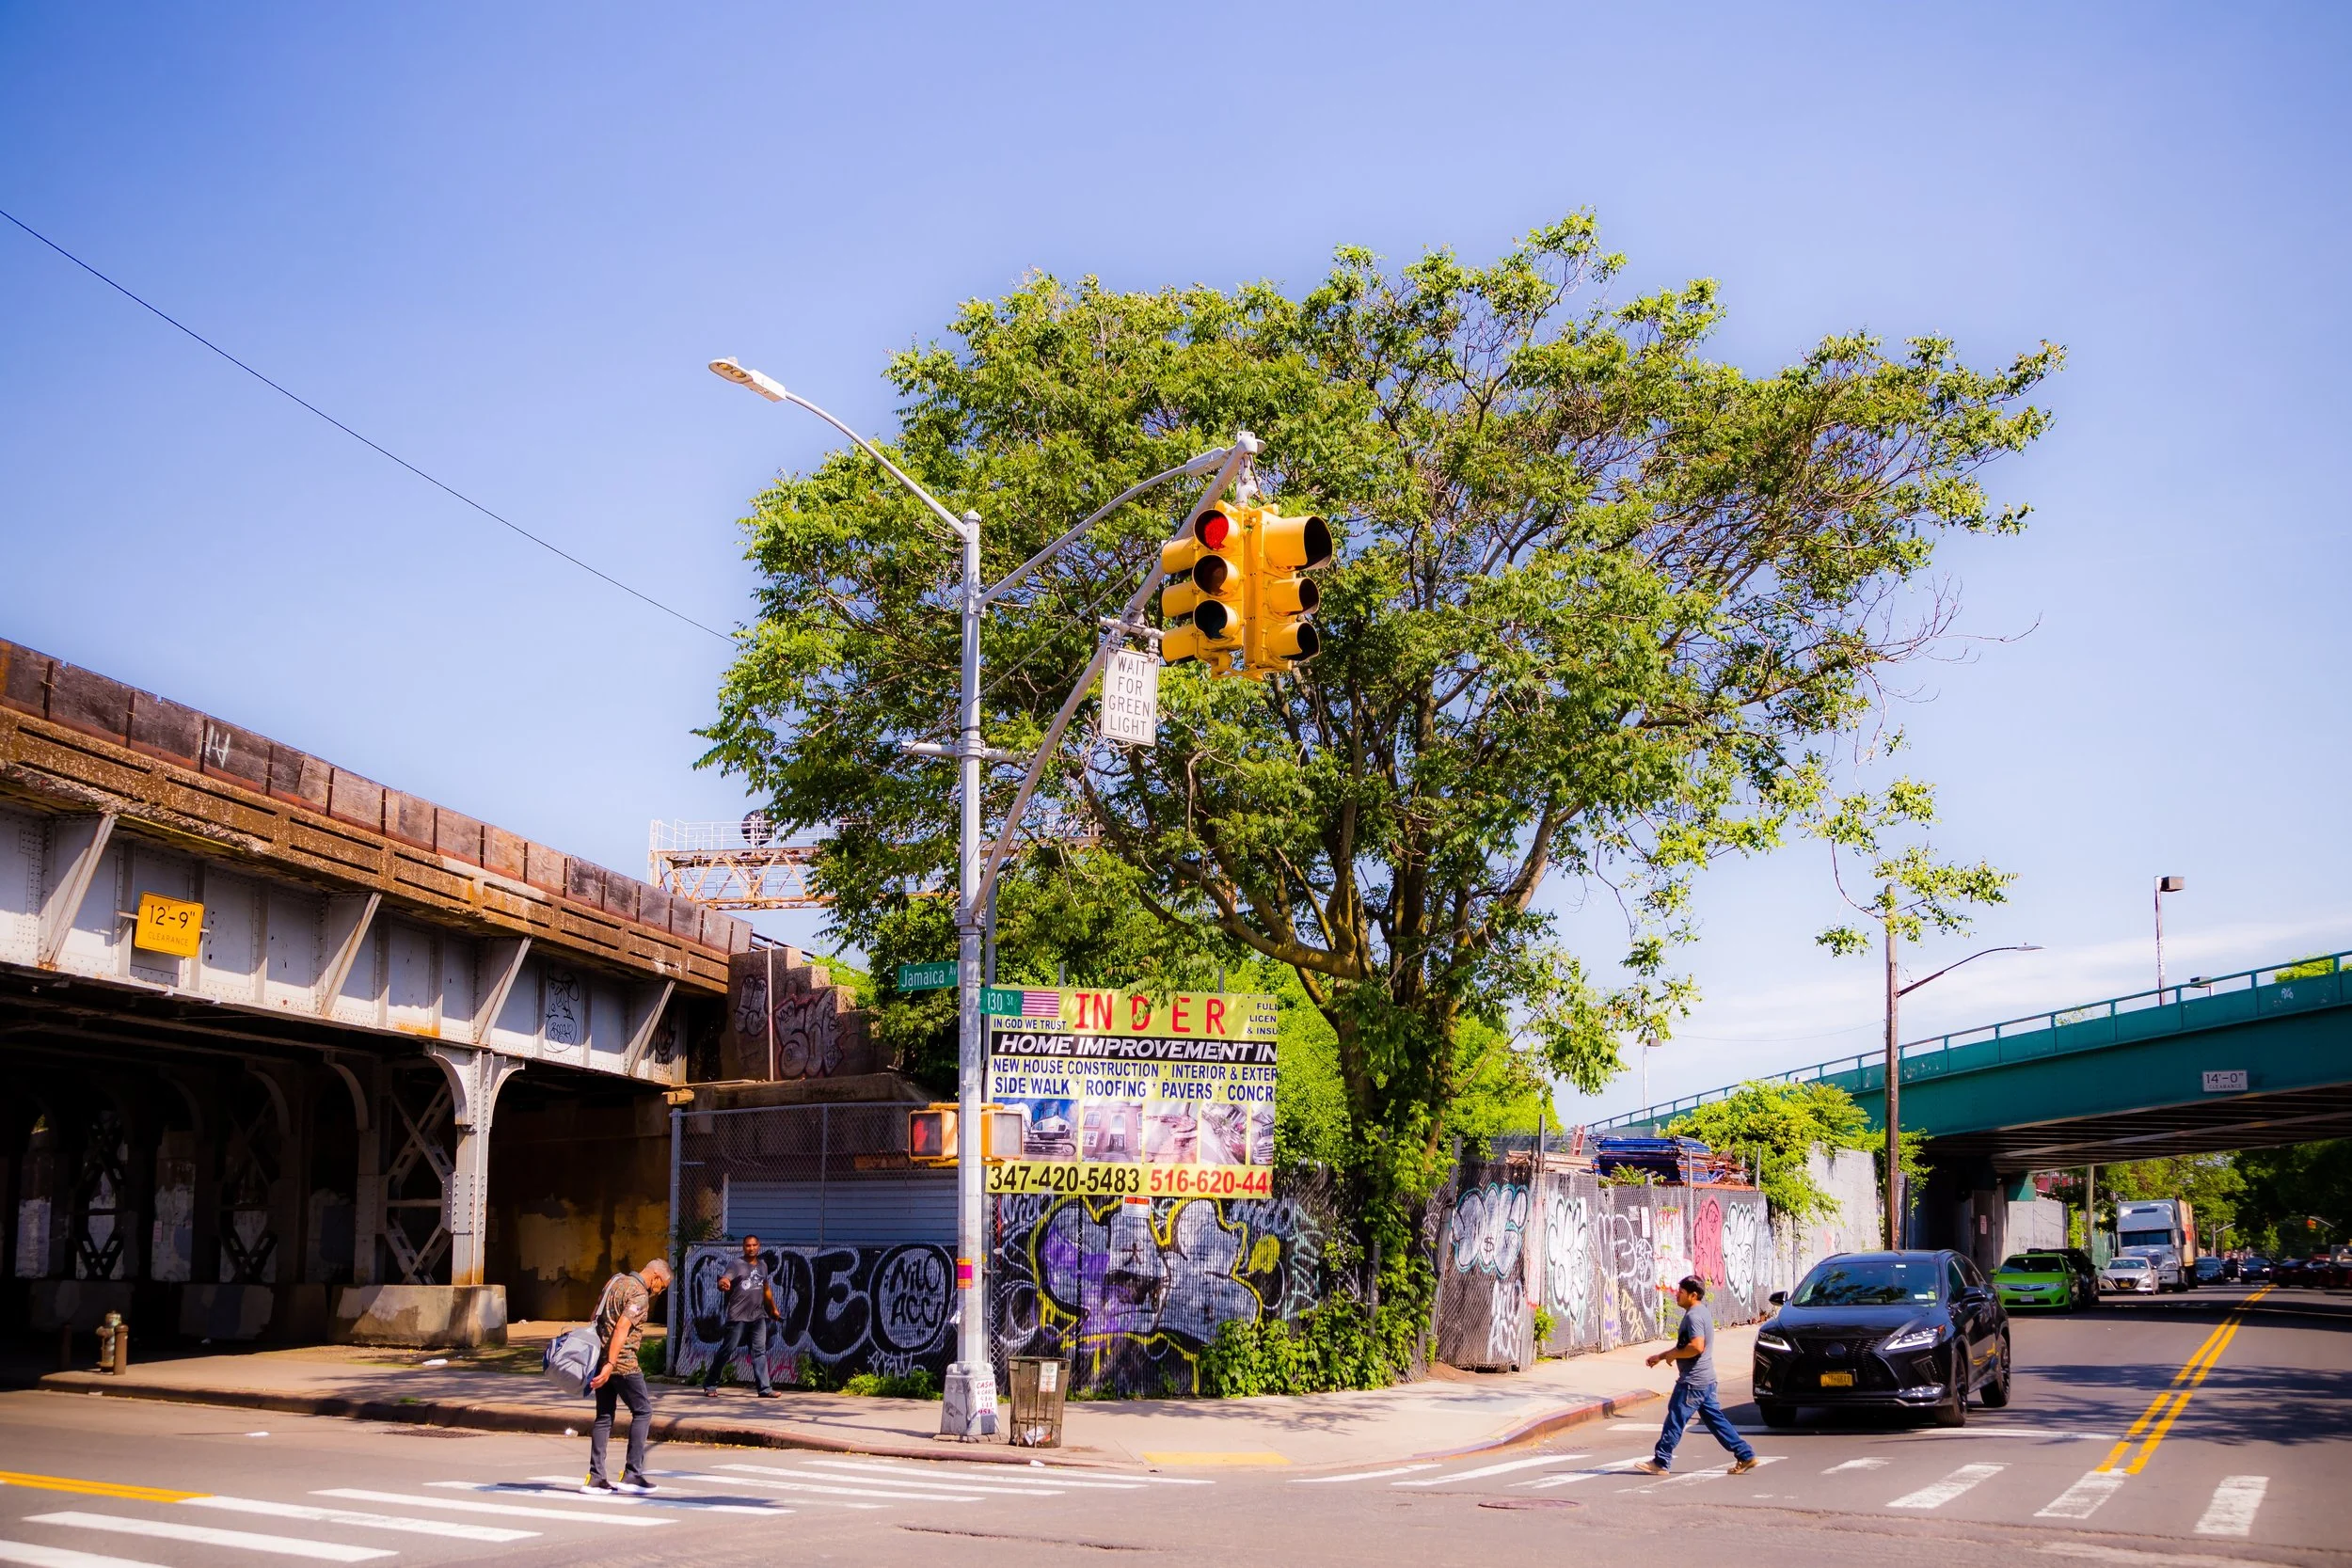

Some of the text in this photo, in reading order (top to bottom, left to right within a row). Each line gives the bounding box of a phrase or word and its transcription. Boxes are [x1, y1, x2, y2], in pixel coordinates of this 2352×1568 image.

[1118, 656, 1147, 676] WAIT
[1118, 675, 1143, 696] FOR
[1108, 694, 1150, 718] GREEN
[1110, 714, 1147, 736] LIGHT
[148, 931, 189, 947] CLEARANCE
[901, 967, 945, 988] Jamaica
[987, 992, 1013, 1011] 130 St
[993, 1018, 1003, 1028] IN
[1005, 1018, 1023, 1029] GOD
[1025, 1019, 1038, 1030] WE
[1247, 1026, 1253, 1035] &
[998, 1034, 1074, 1055] HOME
[1076, 1037, 1253, 1061] IMPROVEMENT
[993, 1058, 1020, 1073] NEW
[1024, 1059, 1064, 1074] HOUSE
[1068, 1061, 1159, 1077] CONSTRUCTION
[1171, 1064, 1226, 1080] INTERIOR
[1230, 1068, 1238, 1081] &
[994, 1076, 1026, 1094] SIDE
[1030, 1078, 1071, 1096] WALK
[1086, 1080, 1147, 1098] ROOFING
[1161, 1082, 1213, 1100] PAVERS
[990, 1165, 1273, 1195] 347-420-5483 516-620-44
[977, 1381, 993, 1389] CASH
